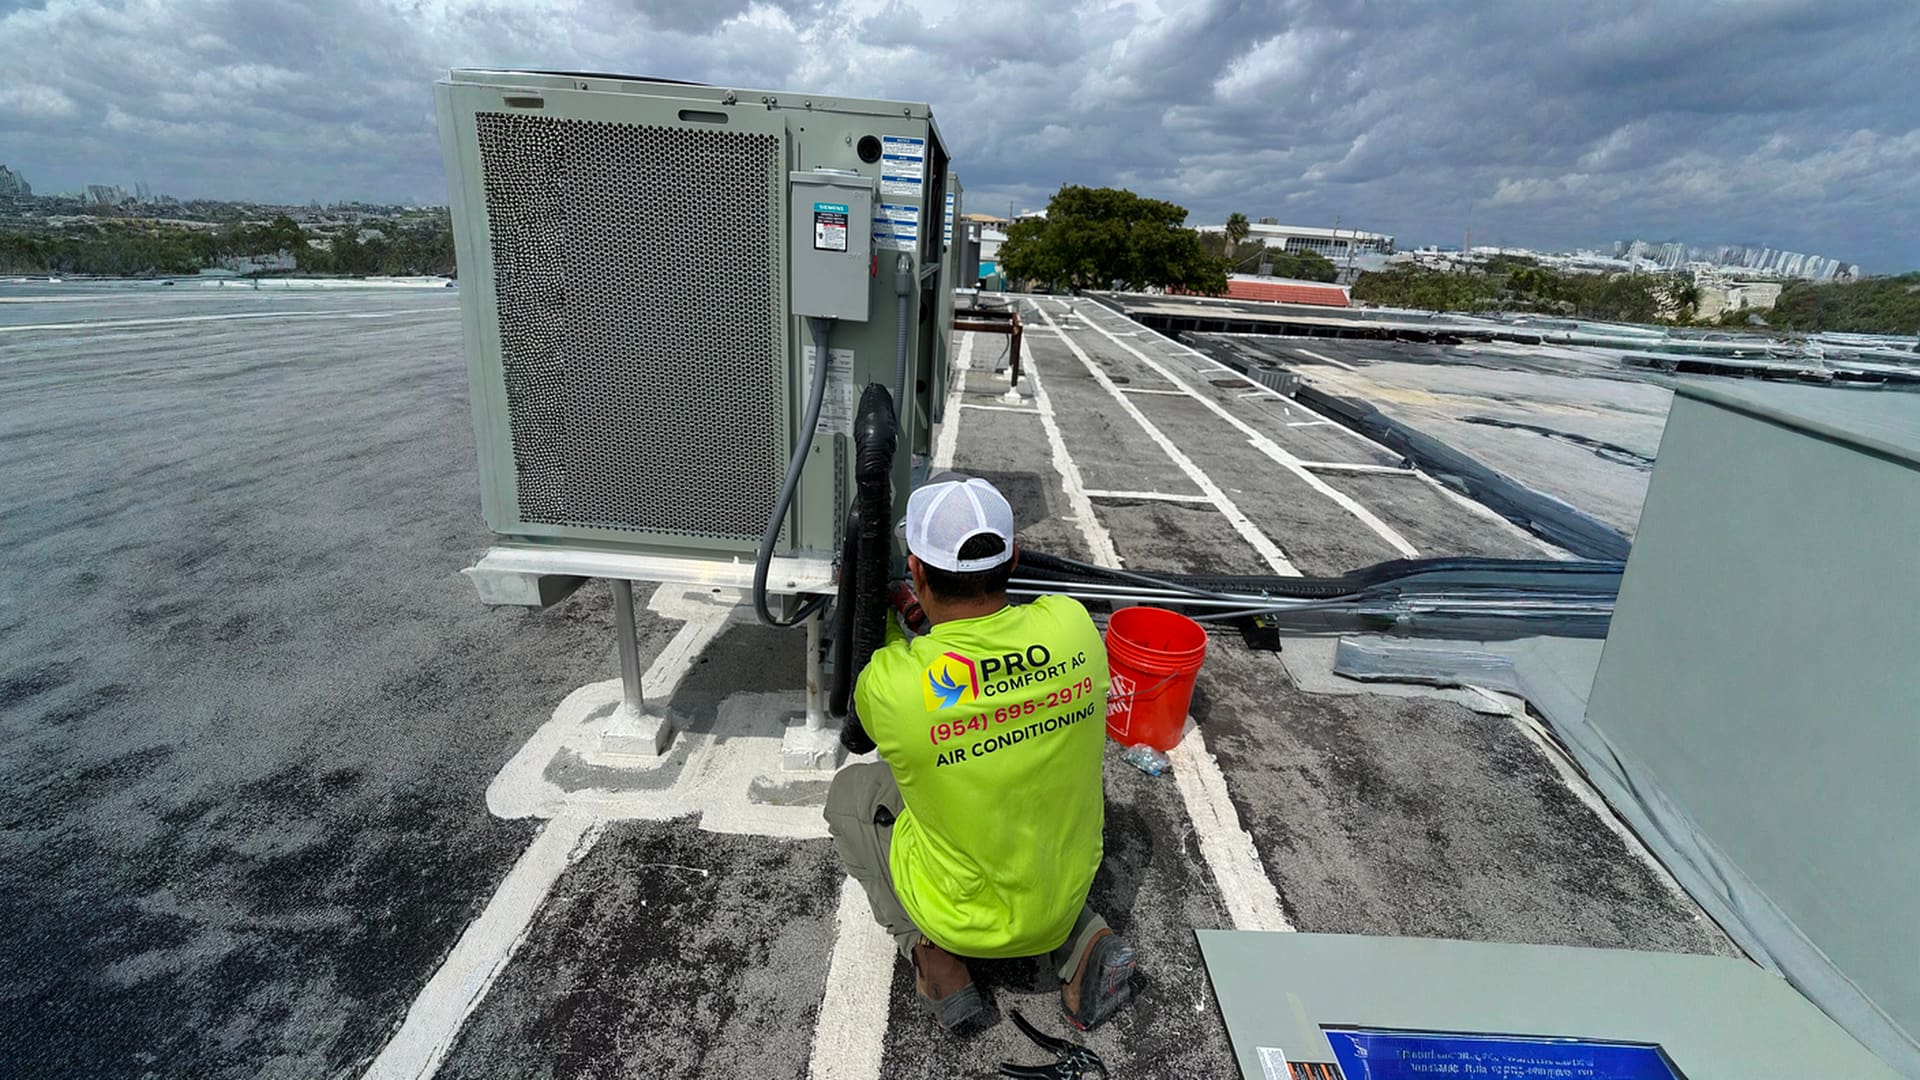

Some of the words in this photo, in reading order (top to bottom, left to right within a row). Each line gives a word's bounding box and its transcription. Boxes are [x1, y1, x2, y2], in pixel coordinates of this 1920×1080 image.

[980, 644, 1051, 682] PRO
[983, 661, 1067, 697] COMFORT
[1071, 651, 1087, 669] AC
[929, 713, 989, 746] (954)
[994, 676, 1093, 724] 695-2979
[936, 748, 967, 768] AIR
[971, 702, 1095, 757] CONDITIONING
